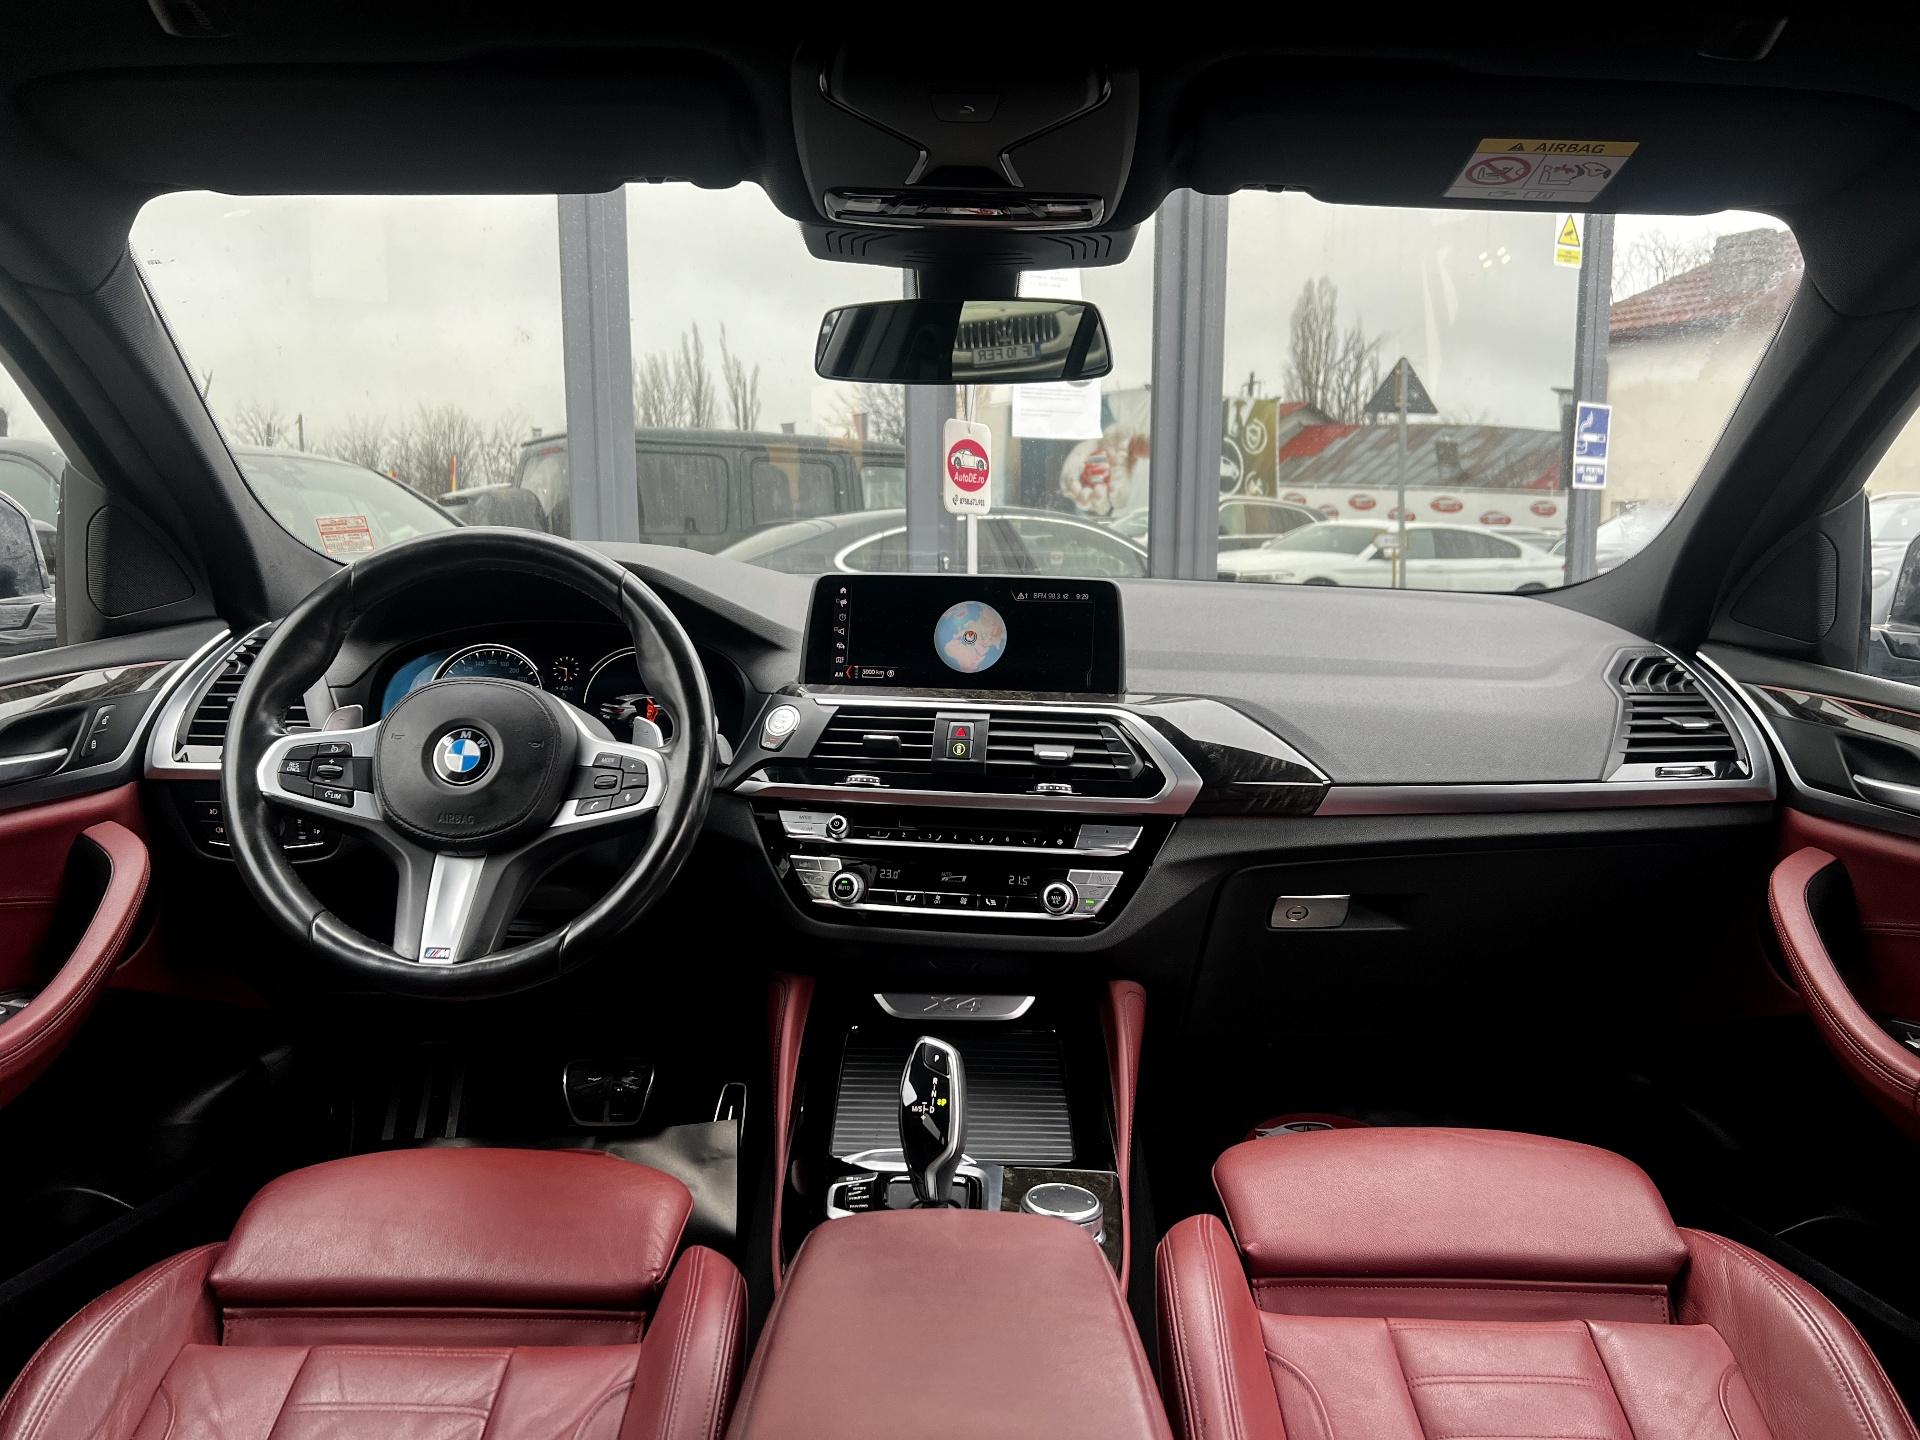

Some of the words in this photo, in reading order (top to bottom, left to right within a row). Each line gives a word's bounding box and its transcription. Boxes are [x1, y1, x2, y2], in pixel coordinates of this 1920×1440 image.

[1533, 142, 1606, 154] AIRBAG
[953, 471, 985, 485] AutoDE.ro
[442, 730, 489, 749] BMW
[330, 792, 342, 800] LIM
[438, 813, 475, 825] AIRBAG
[924, 996, 982, 1012] X4
[934, 1054, 940, 1062] P
[932, 1077, 938, 1085] R
[931, 1090, 937, 1098] N
